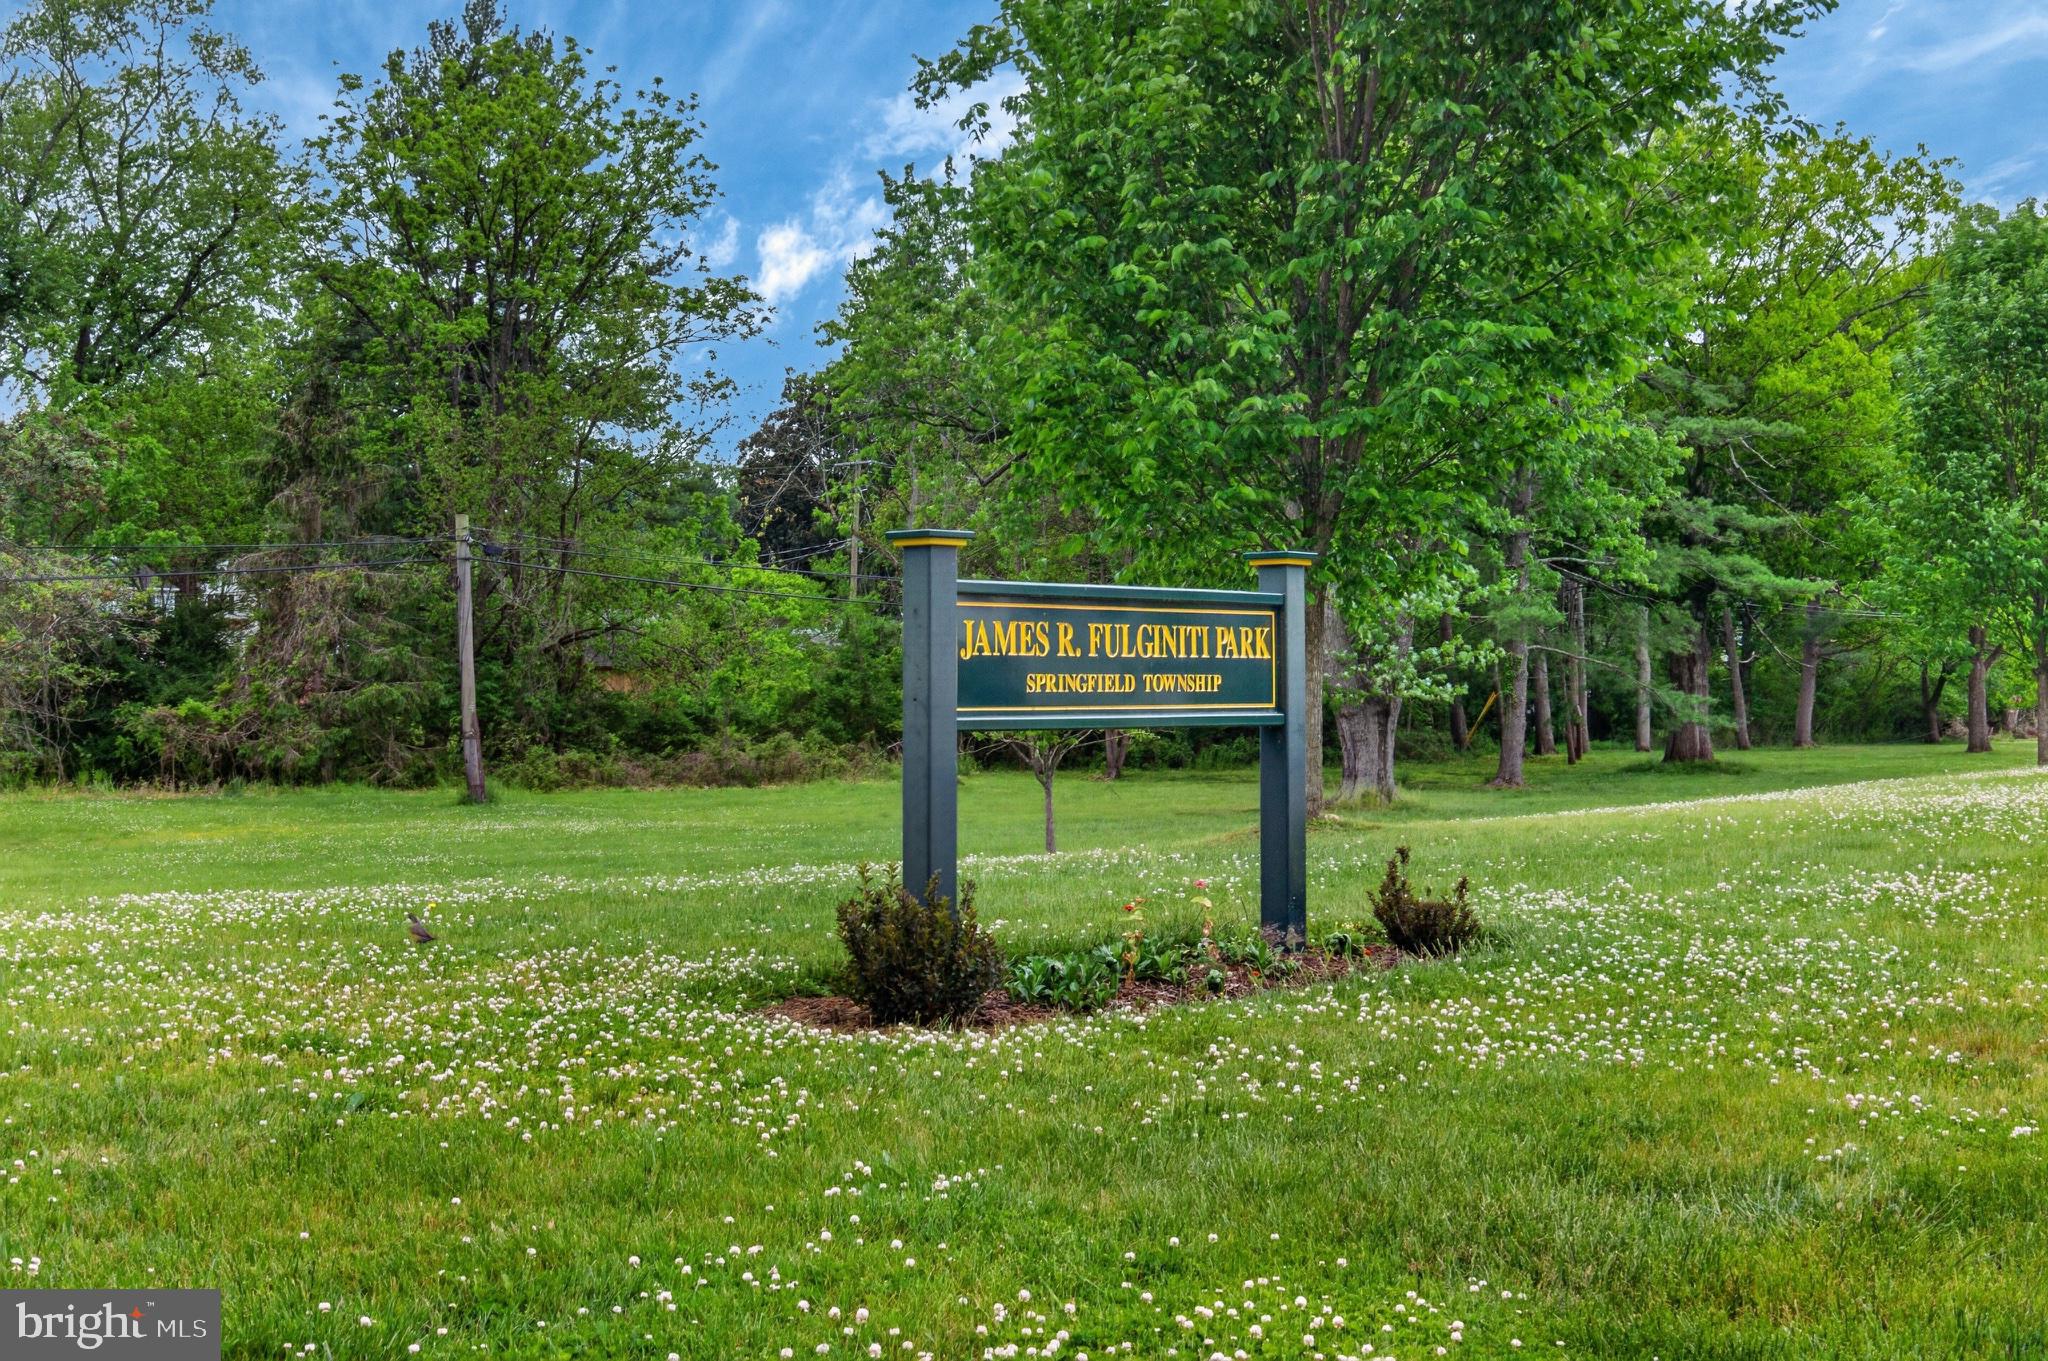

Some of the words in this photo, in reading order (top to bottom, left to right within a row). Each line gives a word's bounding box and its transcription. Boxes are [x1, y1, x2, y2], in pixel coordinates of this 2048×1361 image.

[960, 619, 1050, 660] JAMES
[1056, 621, 1081, 658] R.
[1087, 622, 1212, 659] FULGINITI
[1215, 626, 1271, 660] PARK
[1026, 673, 1136, 693] SPRINGFIELD
[1142, 673, 1222, 693] TOWNSHIP
